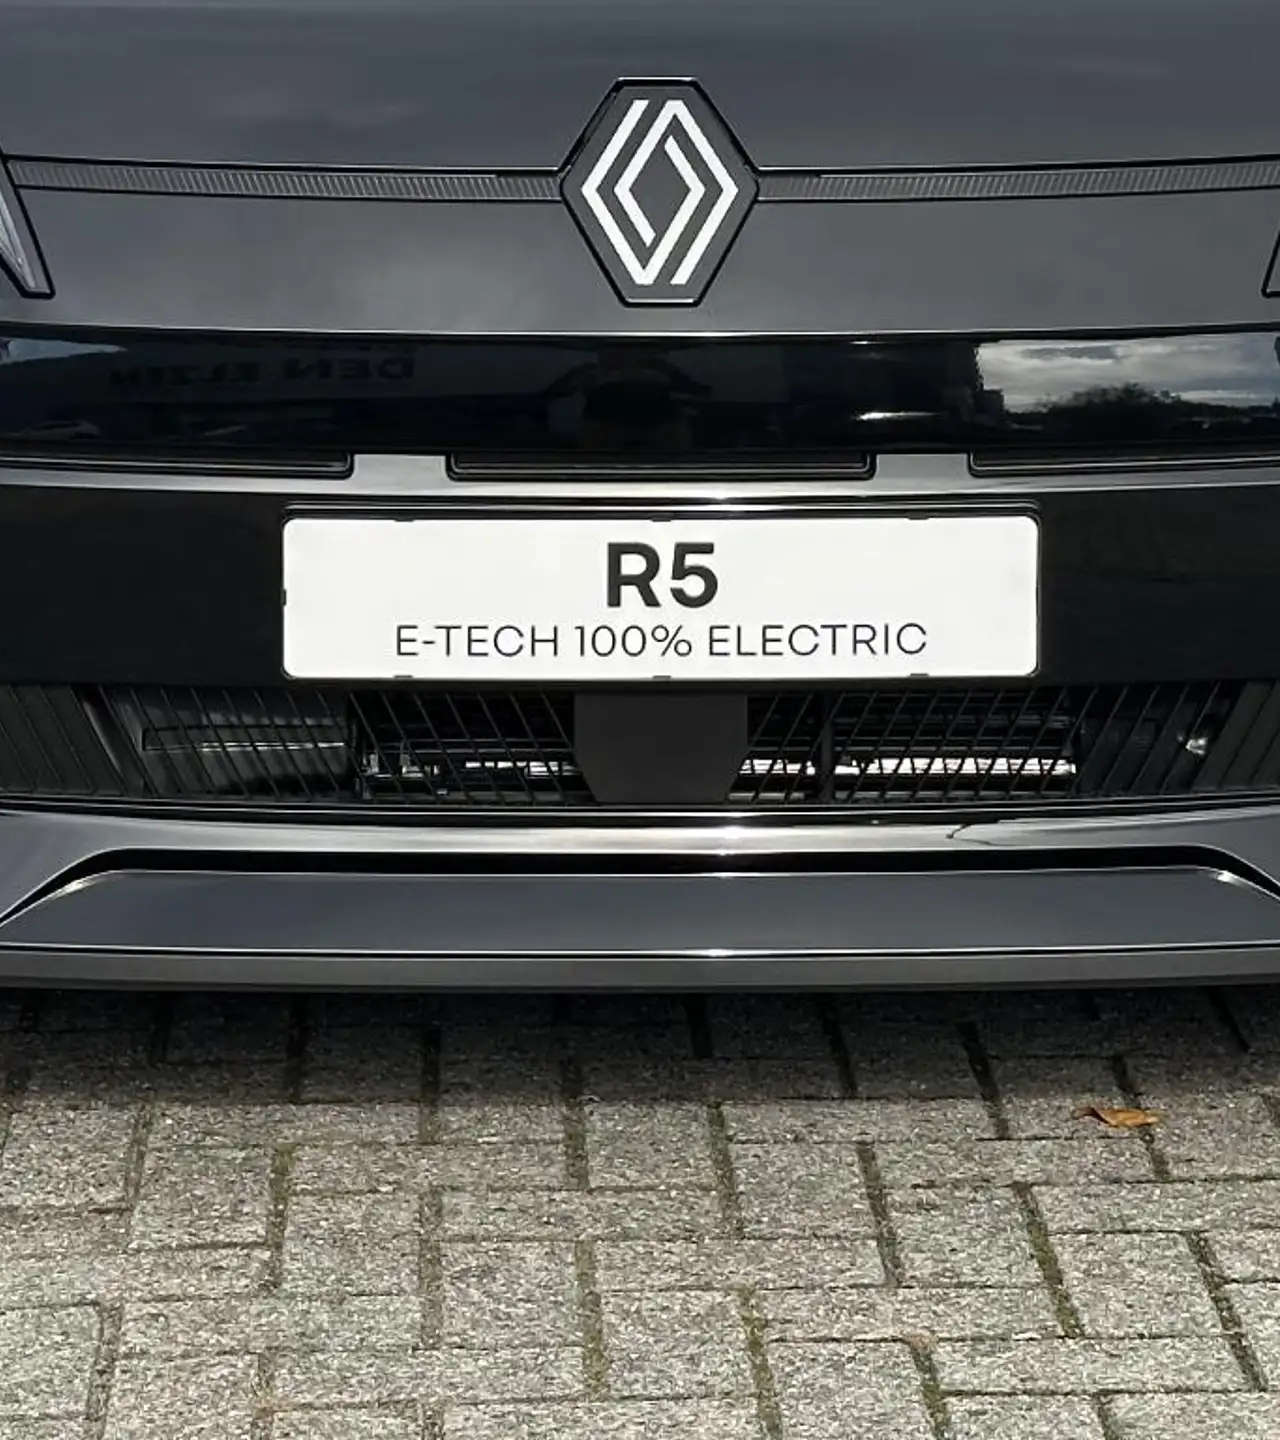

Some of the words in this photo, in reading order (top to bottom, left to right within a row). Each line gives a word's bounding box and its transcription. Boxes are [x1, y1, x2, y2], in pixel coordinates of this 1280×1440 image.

[606, 542, 719, 608] R5
[395, 624, 558, 658] E-TECH
[573, 624, 693, 658] 100%
[707, 622, 928, 657] ELECTRIC
